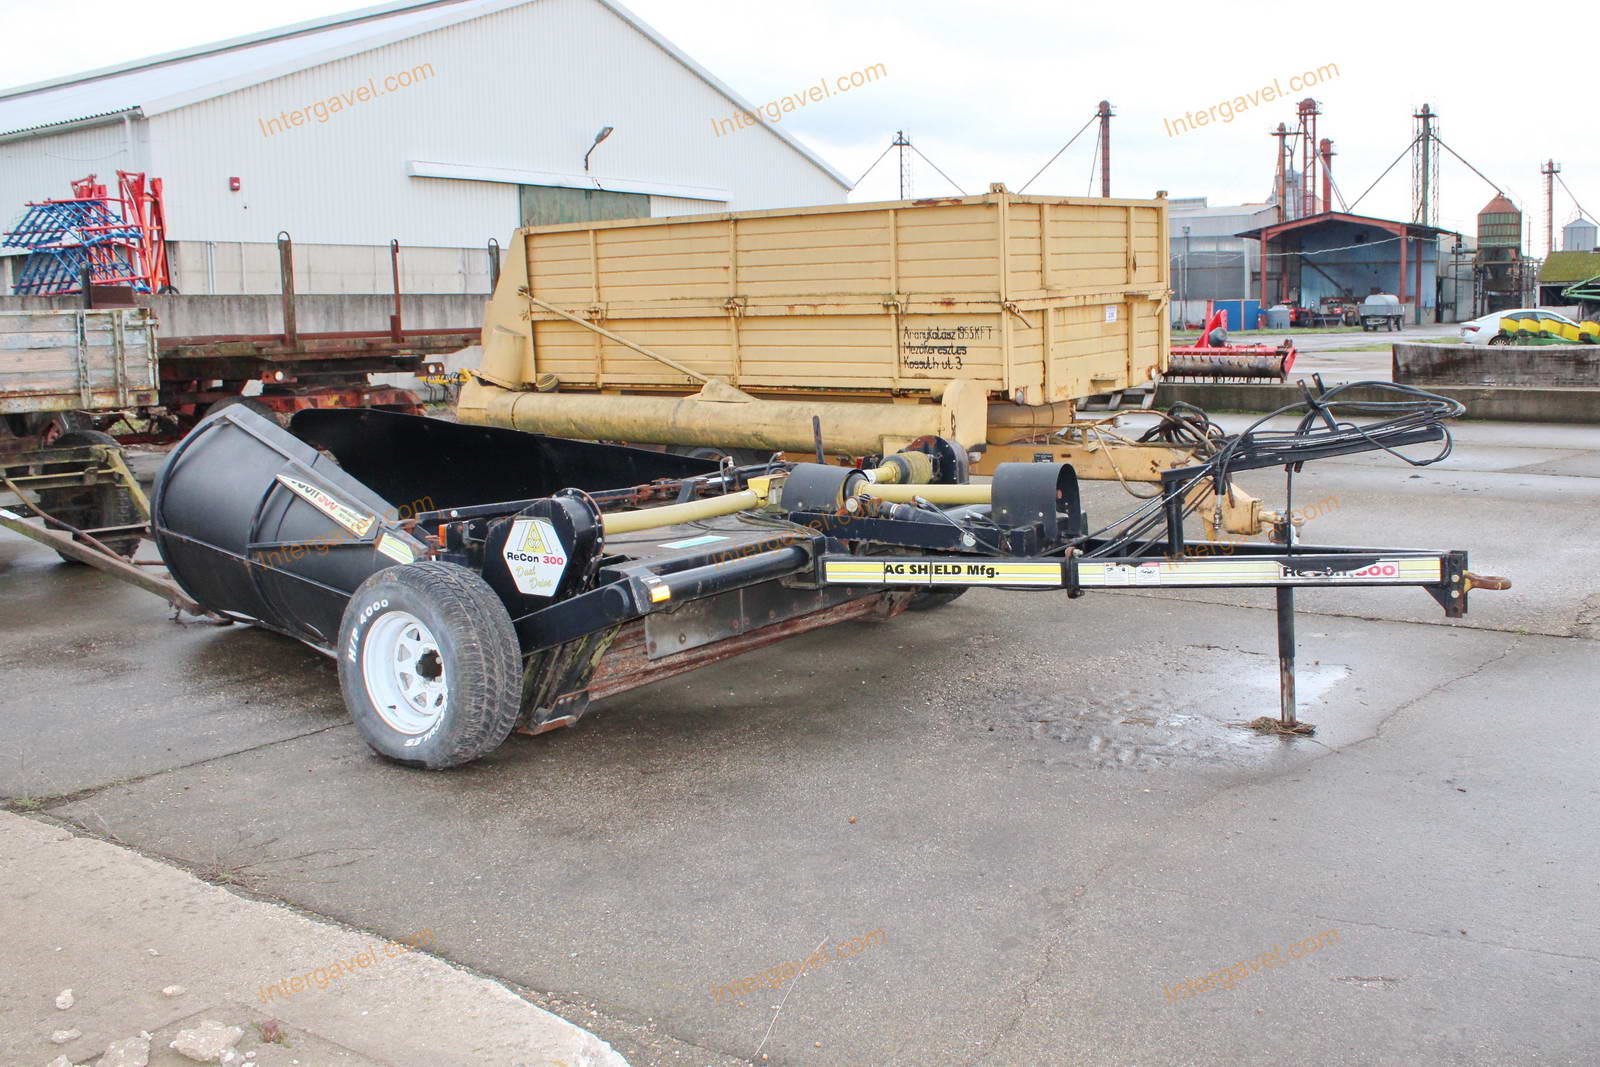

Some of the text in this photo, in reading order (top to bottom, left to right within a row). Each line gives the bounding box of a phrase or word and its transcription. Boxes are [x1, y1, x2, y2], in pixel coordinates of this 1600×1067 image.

[955, 356, 963, 370] 3
[507, 551, 564, 566] ReCon 300
[885, 564, 1000, 578] AG SHIELD Mfg.
[348, 599, 389, 663] H/P 4000
